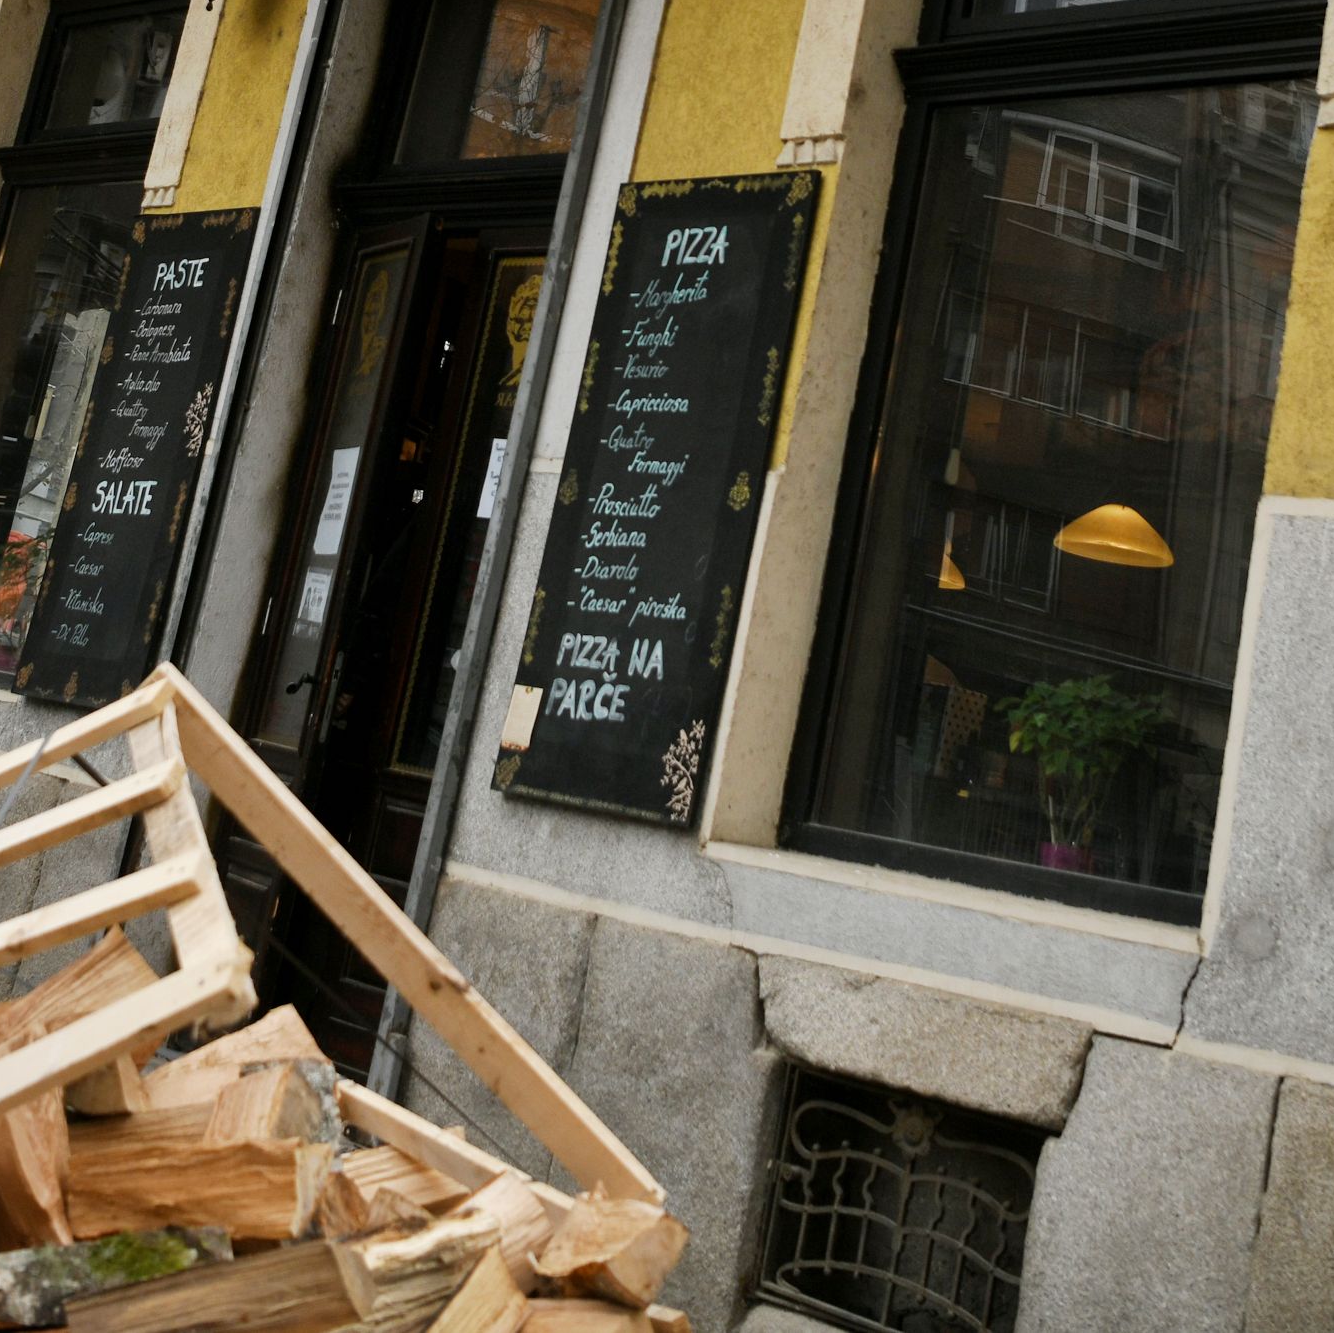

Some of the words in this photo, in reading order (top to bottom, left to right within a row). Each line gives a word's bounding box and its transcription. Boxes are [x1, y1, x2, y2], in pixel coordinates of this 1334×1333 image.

[661, 225, 729, 267] PIZZA
[153, 257, 210, 291] PASTE
[628, 451, 690, 486] Formaggi
[92, 480, 158, 515] SALATE
[557, 633, 620, 671] PIZZA
[628, 638, 663, 680] NA
[545, 671, 631, 722] PARČE
